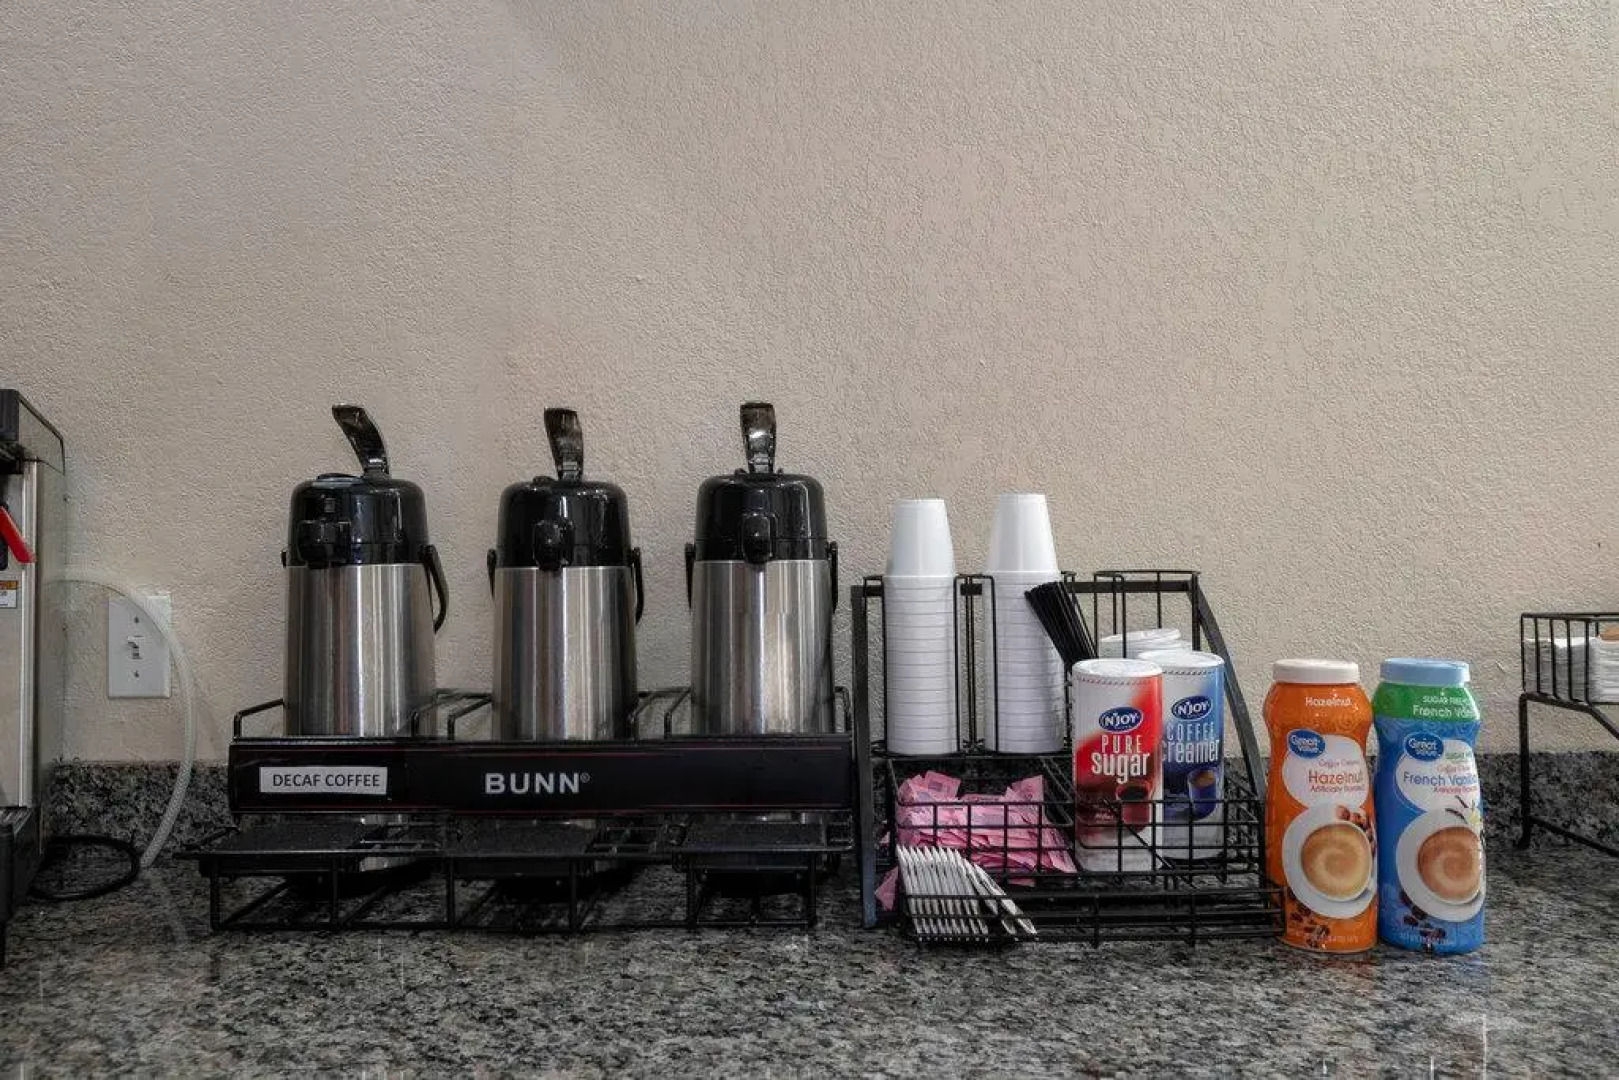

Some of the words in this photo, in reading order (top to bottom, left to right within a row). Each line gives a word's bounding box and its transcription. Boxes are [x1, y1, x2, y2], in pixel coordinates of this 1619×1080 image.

[1166, 721, 1215, 741] COFFEE
[1101, 734, 1143, 754] PURE
[272, 773, 321, 787] DECAF
[325, 774, 381, 788] COFFEE
[1403, 771, 1446, 787] French
